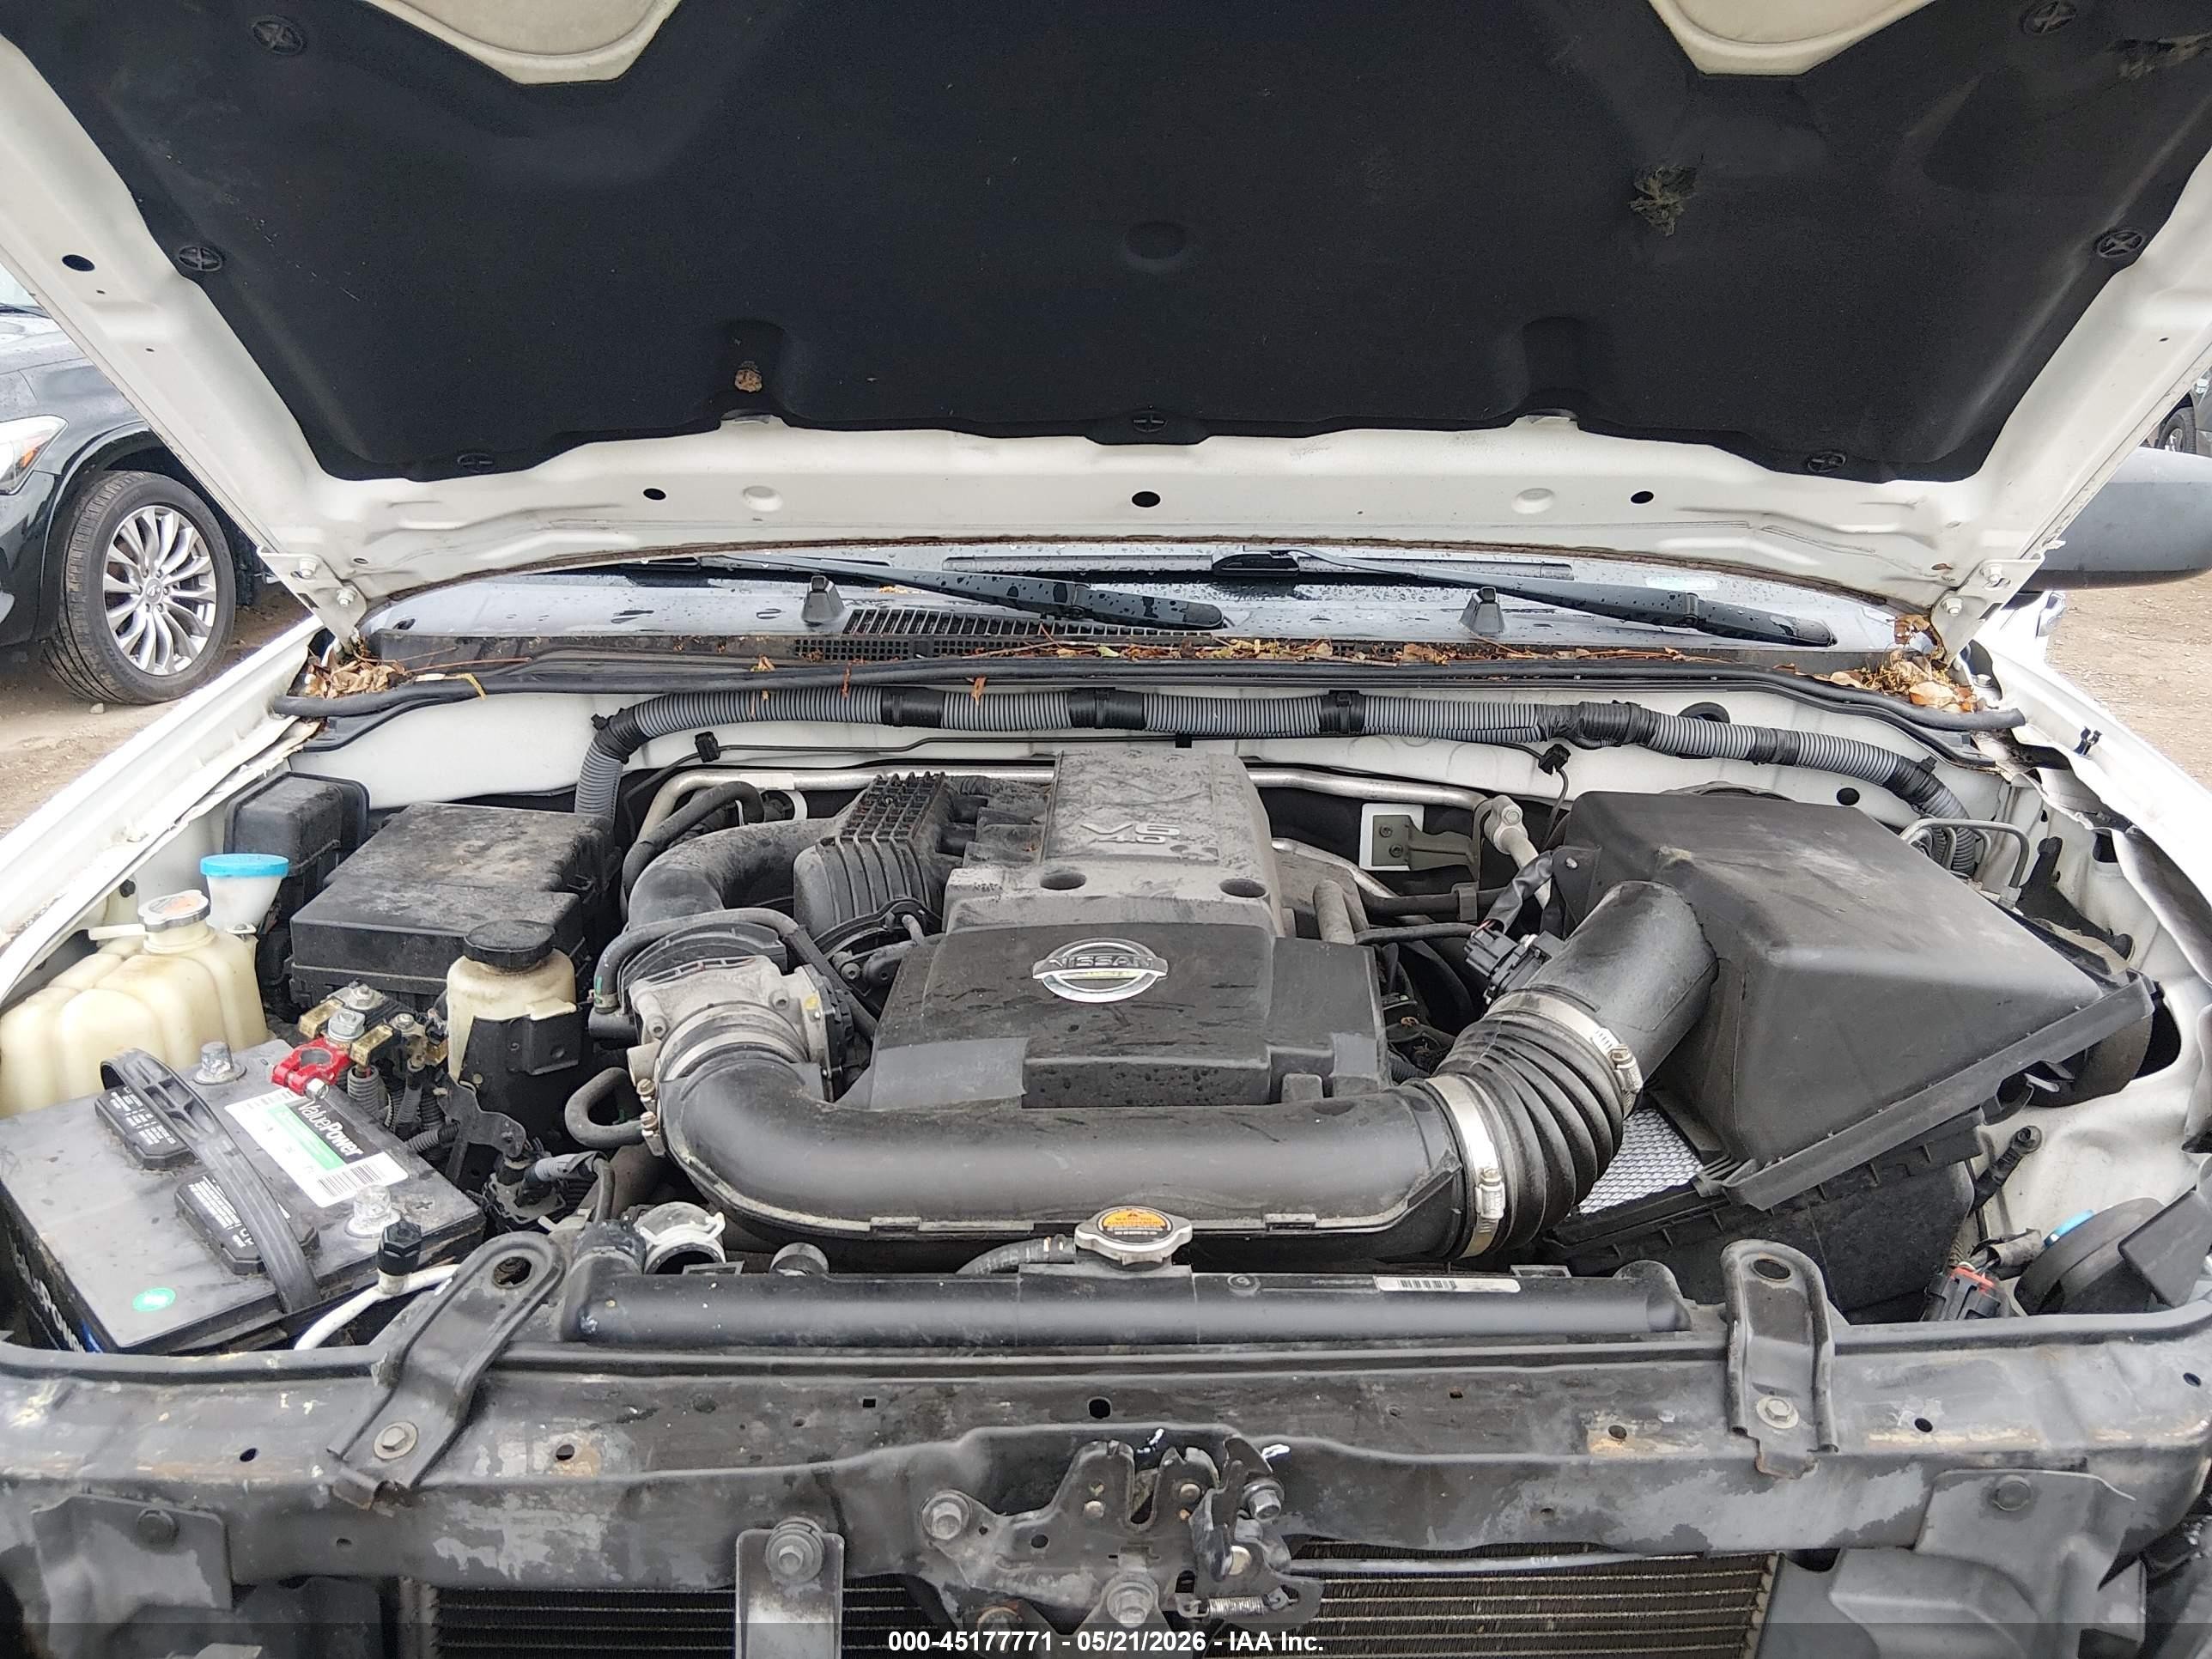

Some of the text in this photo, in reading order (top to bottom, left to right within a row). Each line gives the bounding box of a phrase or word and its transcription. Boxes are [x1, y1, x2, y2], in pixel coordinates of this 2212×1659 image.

[1079, 822, 1181, 836] V6
[1048, 955, 1155, 969] NISSAN
[297, 1100, 365, 1157] ValuePower
